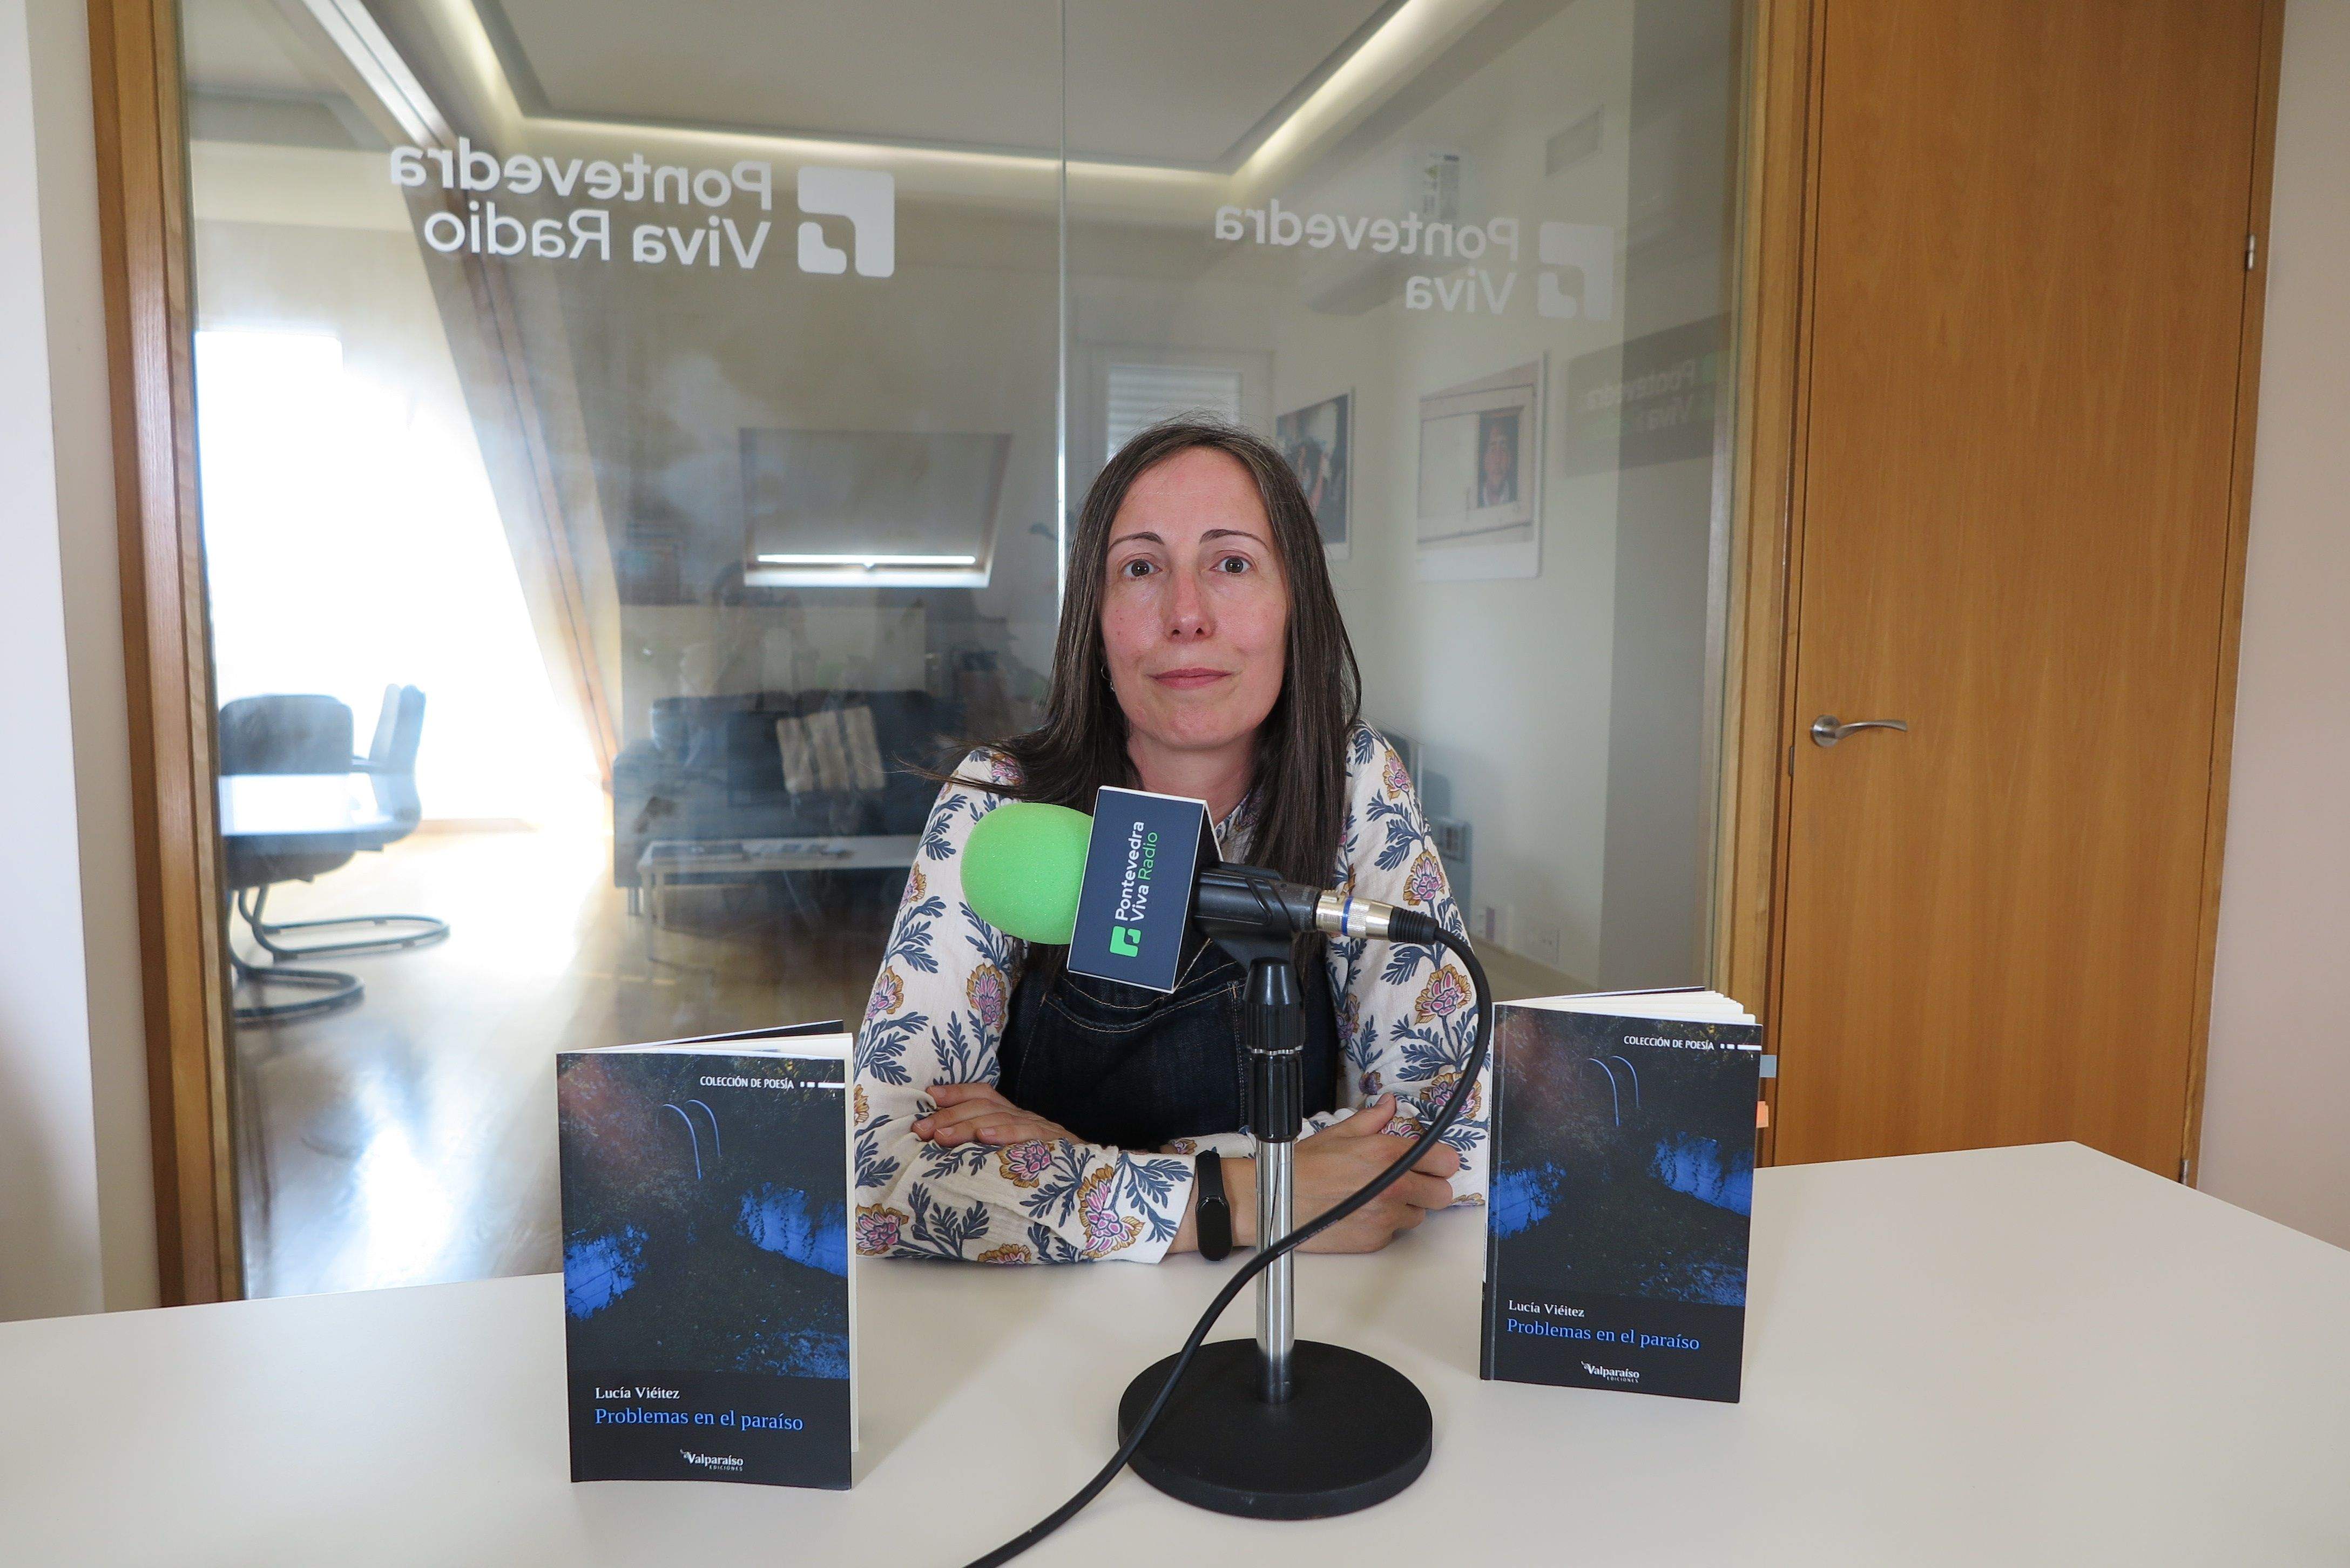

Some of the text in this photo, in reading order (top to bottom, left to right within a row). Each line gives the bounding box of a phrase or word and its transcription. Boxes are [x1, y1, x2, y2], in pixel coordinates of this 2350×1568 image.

[1115, 821, 1145, 921] Pontevedra
[1130, 832, 1158, 922] Viva Radio
[1624, 1035, 1714, 1051] COLECCIÓN DE POESÍA
[700, 1075, 794, 1090] COLECCIÓN DE POESÍA
[1508, 1299, 1585, 1318] Lucía Viéitez
[1507, 1317, 1700, 1350] Problemas en el paraíso
[1585, 1364, 1640, 1378] Valparaíso
[595, 1387, 680, 1400] Lucía Viéitez
[595, 1408, 804, 1431] Problemas en el paraíso
[686, 1452, 744, 1467] Valparaíso
